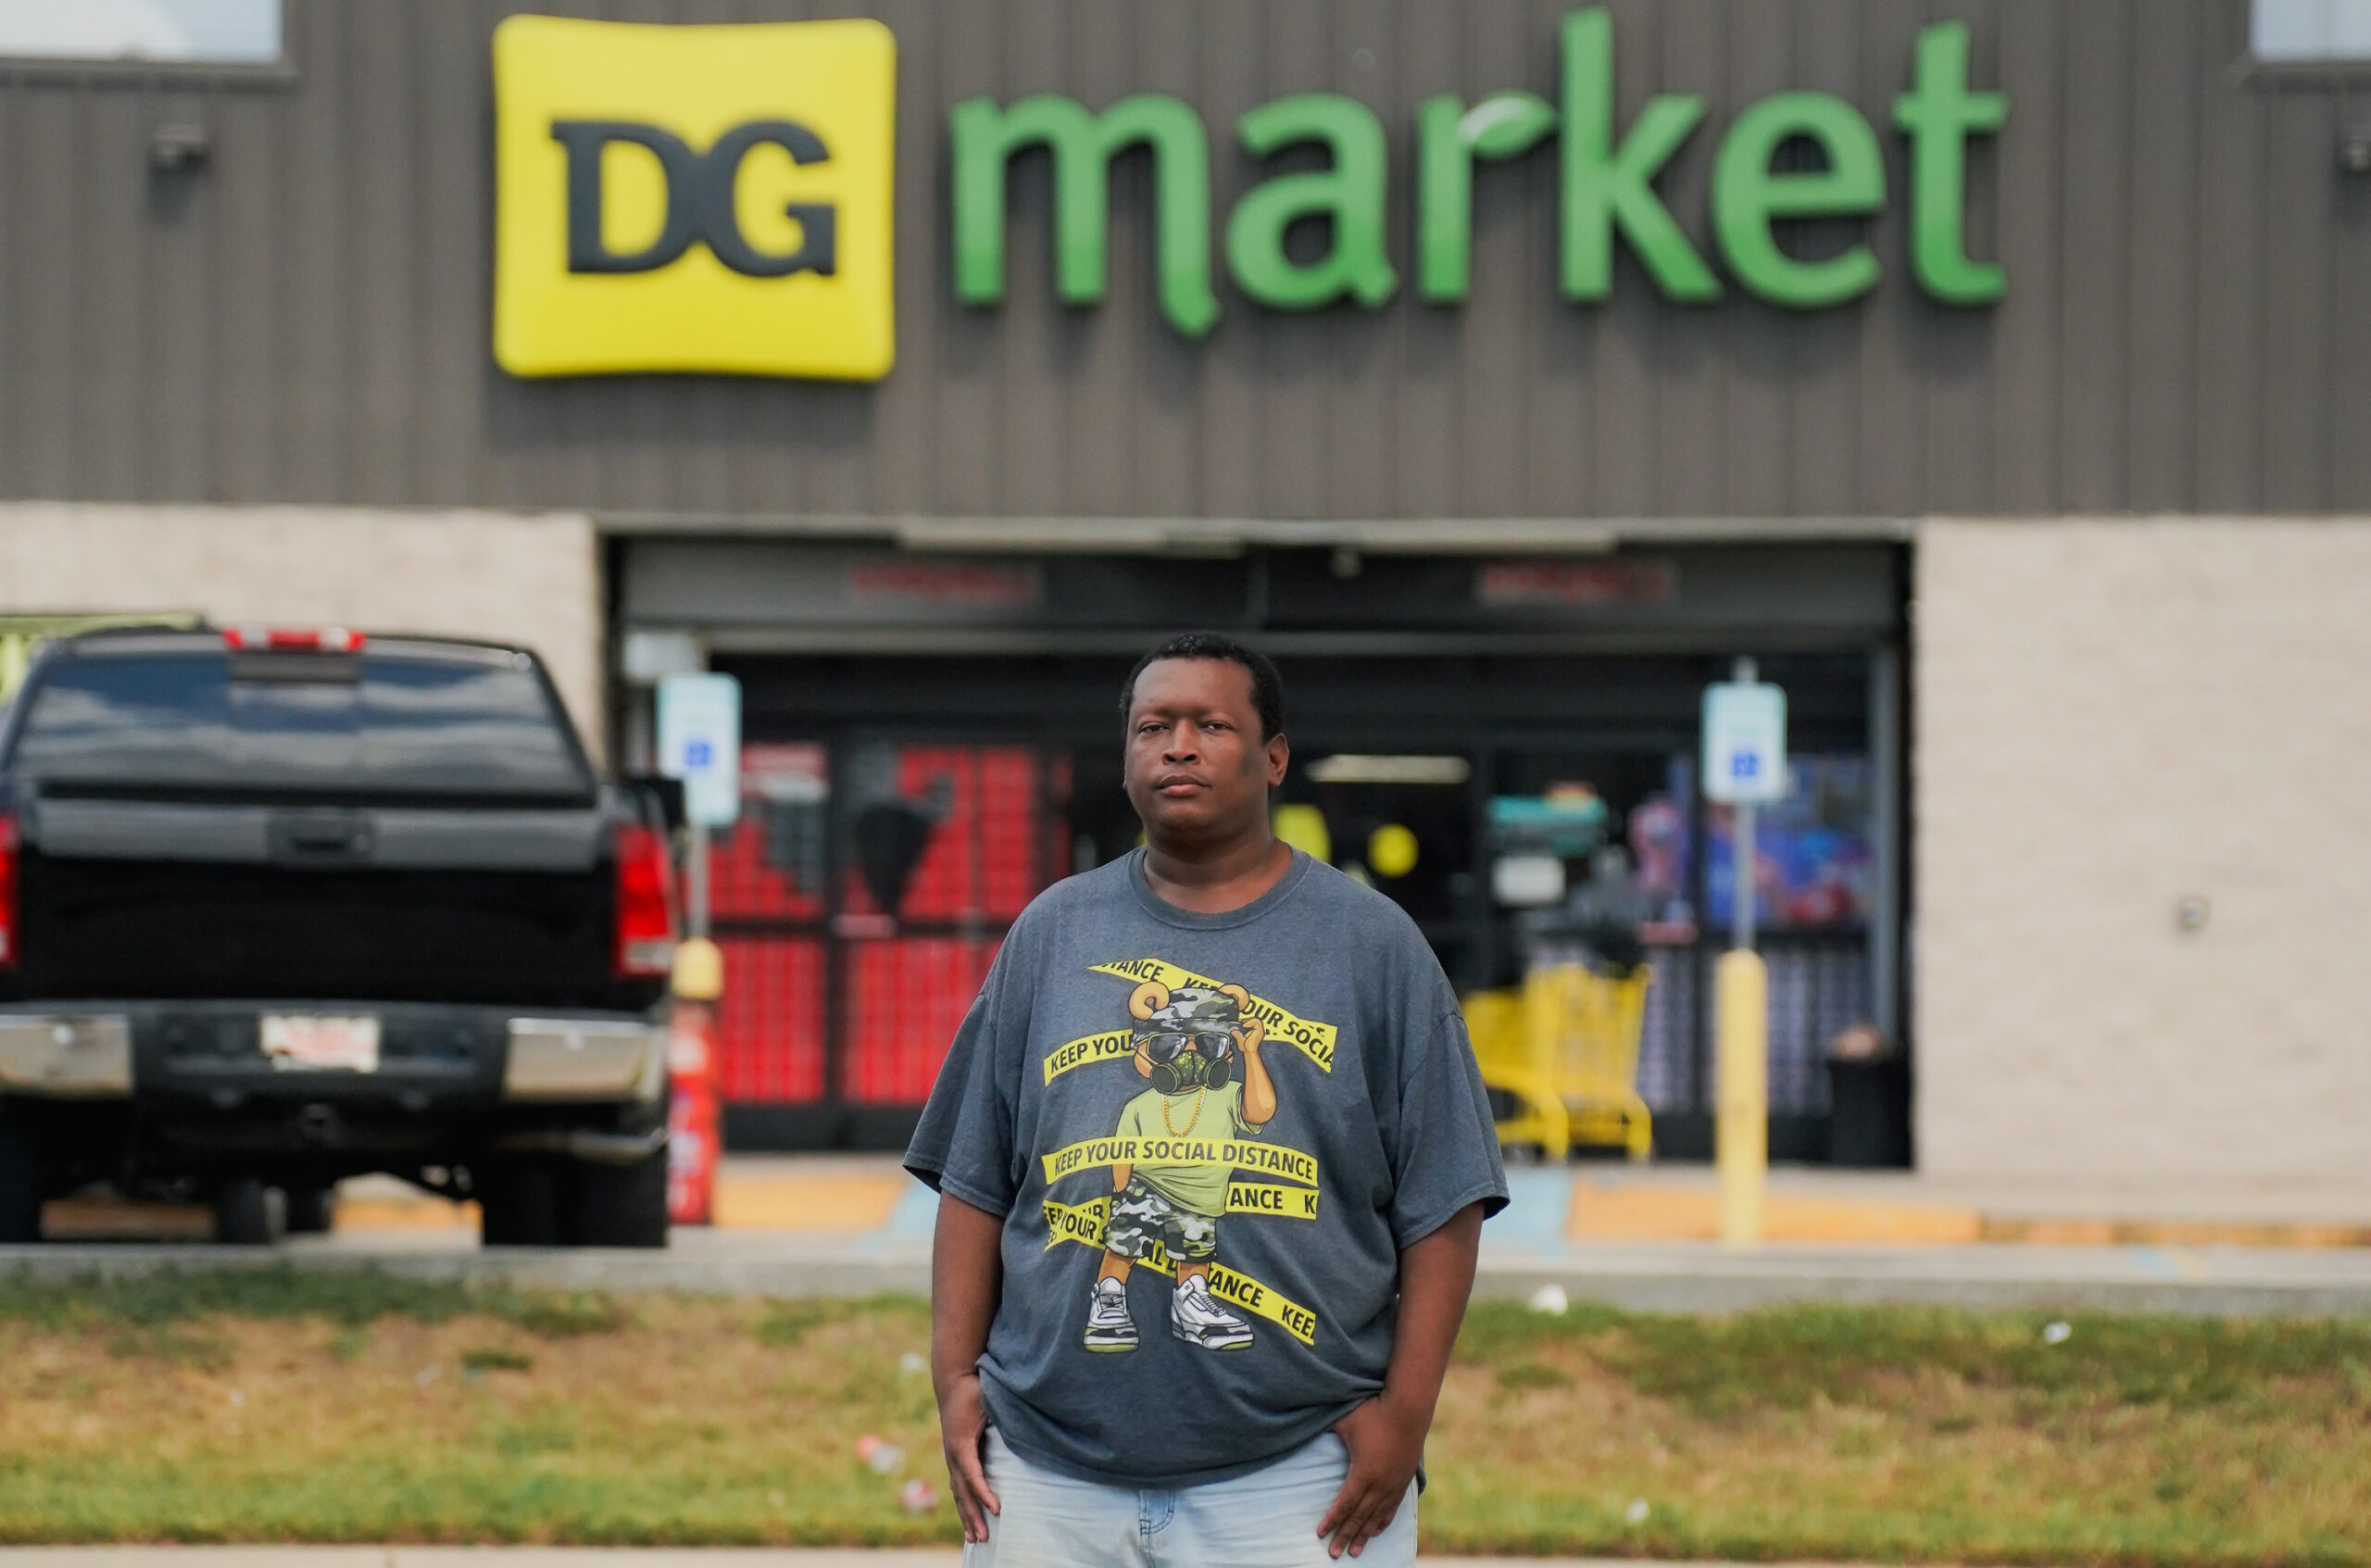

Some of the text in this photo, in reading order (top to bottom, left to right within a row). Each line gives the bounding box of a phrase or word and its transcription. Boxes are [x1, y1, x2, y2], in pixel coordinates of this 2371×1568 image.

[550, 5, 2010, 339] DG market
[1101, 960, 1164, 982] ANCE
[1241, 998, 1284, 1028] OUR
[1050, 1034, 1134, 1074] KEEP YOU
[1054, 1140, 1312, 1180] KEEP YOUR SOCIAL DISTANCE
[1229, 1187, 1284, 1210] ANCE
[1208, 1266, 1315, 1340] ANCE KEE
